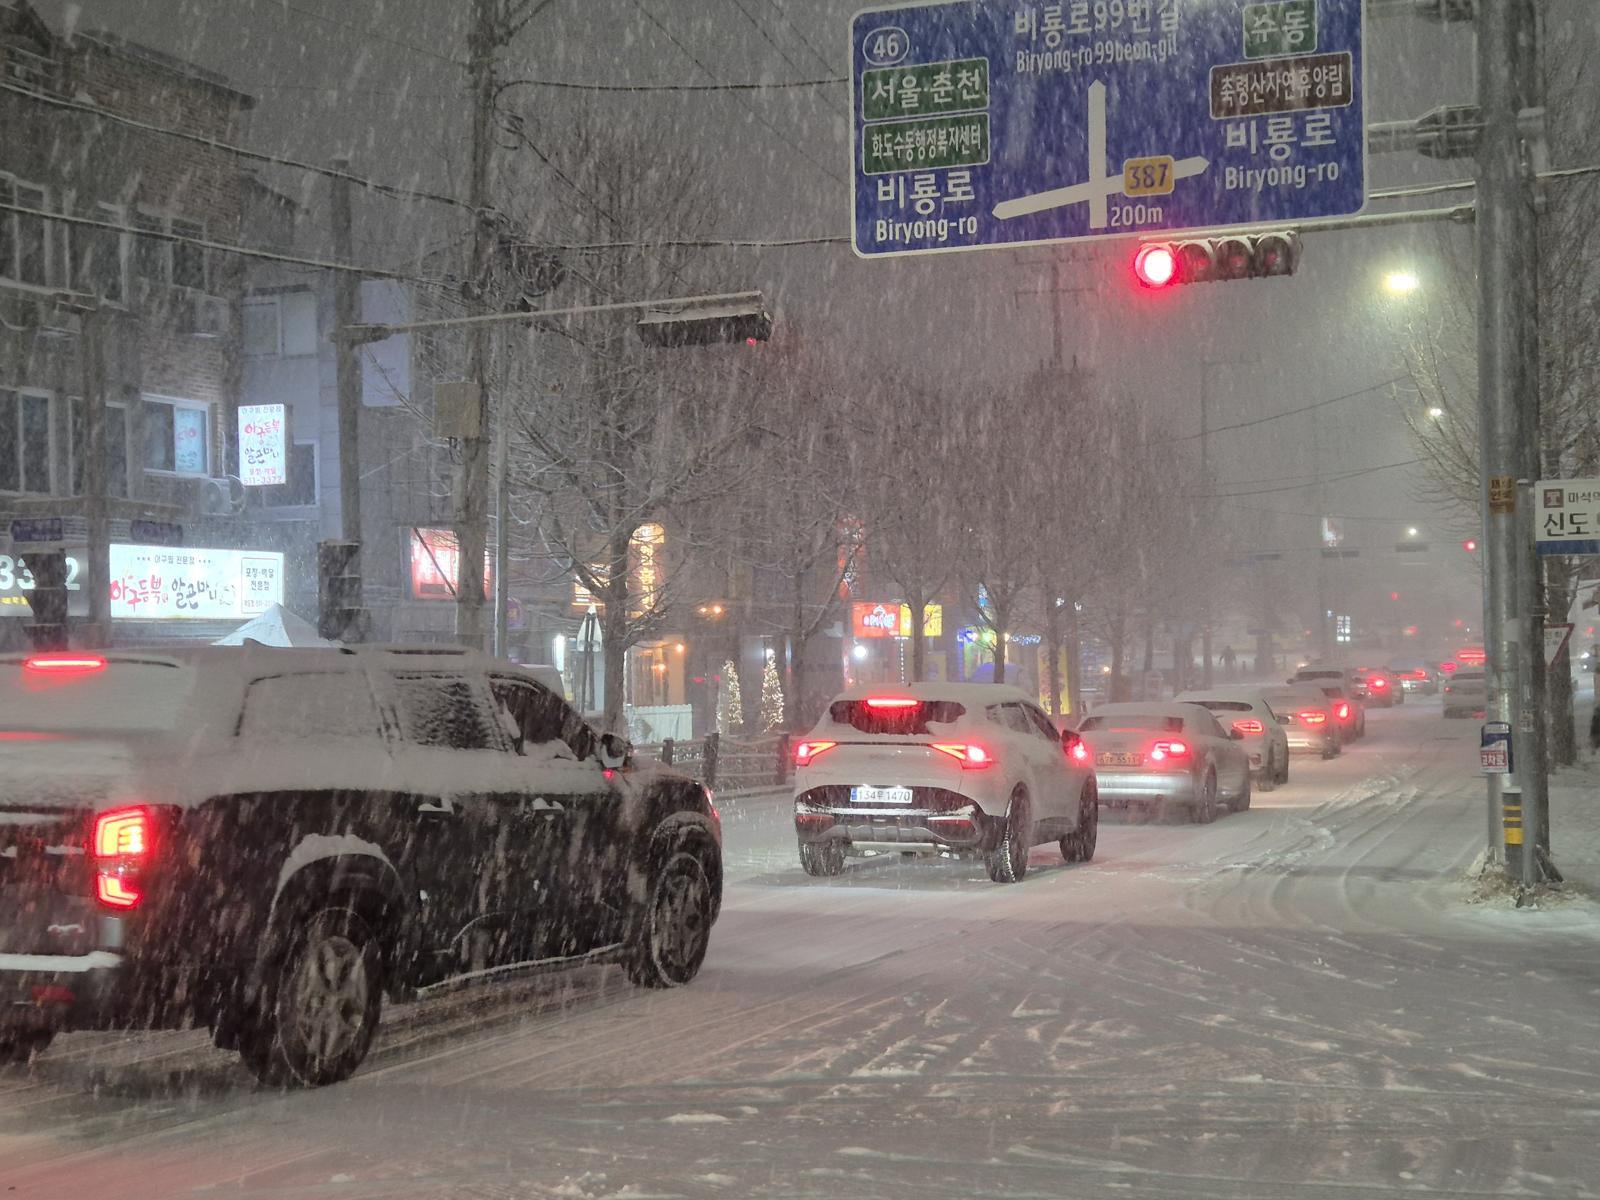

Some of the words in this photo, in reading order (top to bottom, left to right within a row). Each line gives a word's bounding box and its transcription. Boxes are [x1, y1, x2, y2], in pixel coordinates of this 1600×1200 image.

[1251, 10, 1310, 44] 수동
[873, 33, 899, 58] 46
[1016, 46, 1093, 75] Biryong-ro
[1095, 33, 1179, 65] 99beon-gil
[1219, 63, 1343, 107] 축령산자연휴양림
[871, 123, 981, 162] 화도수동행정복지센터
[1225, 113, 1337, 161] 비룡로
[877, 170, 976, 215] 비룡로
[1128, 163, 1169, 190] 387
[1224, 161, 1340, 193] Biryong-ro
[876, 215, 978, 244] Biryong-ro
[1110, 204, 1163, 227] 200m
